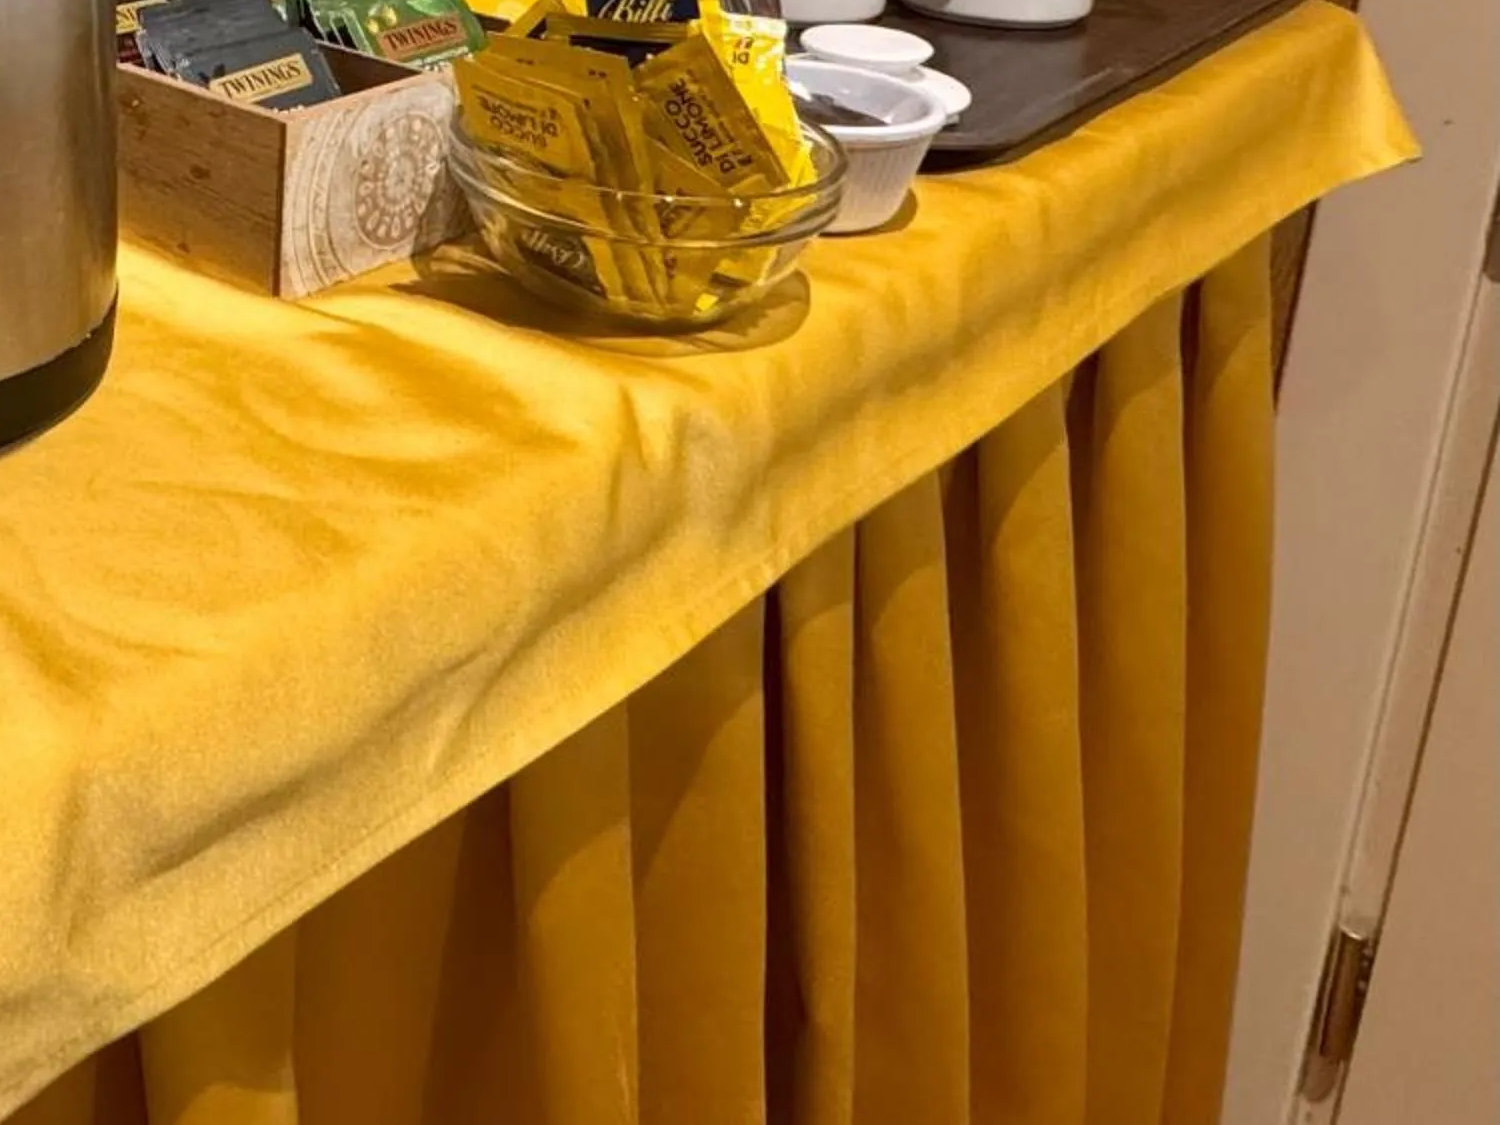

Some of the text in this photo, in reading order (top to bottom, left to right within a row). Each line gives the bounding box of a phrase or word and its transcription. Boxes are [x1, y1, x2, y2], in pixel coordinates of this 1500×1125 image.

[384, 20, 458, 51] TWININGS
[218, 60, 302, 97] TWININGS
[664, 99, 713, 166] SUCCO
